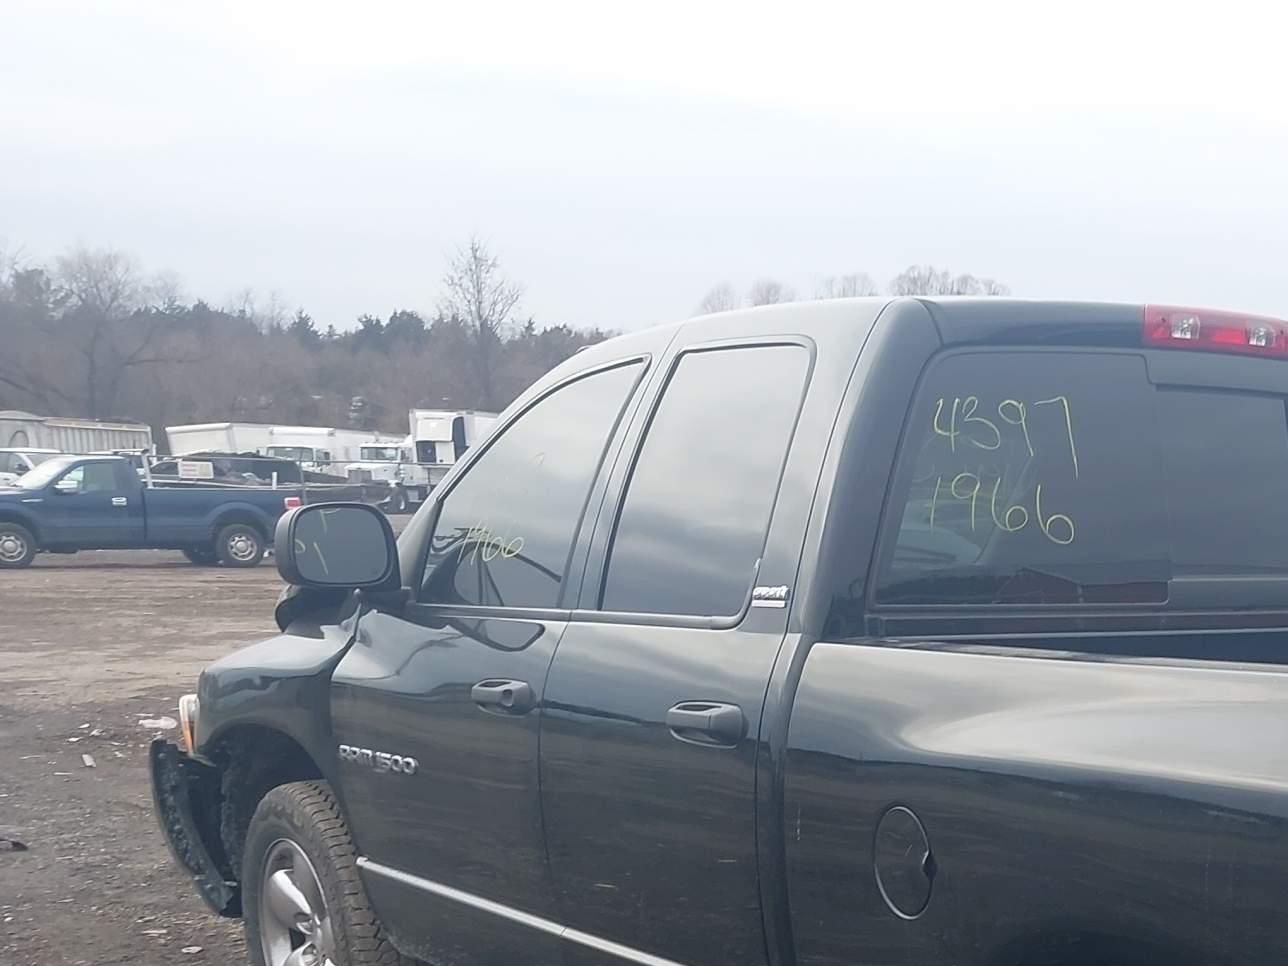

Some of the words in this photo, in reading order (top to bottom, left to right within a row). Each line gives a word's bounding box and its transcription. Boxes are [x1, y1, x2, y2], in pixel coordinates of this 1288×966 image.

[934, 396, 1079, 480] 4397
[930, 472, 1075, 545] 1966
[374, 751, 418, 775] 1500
